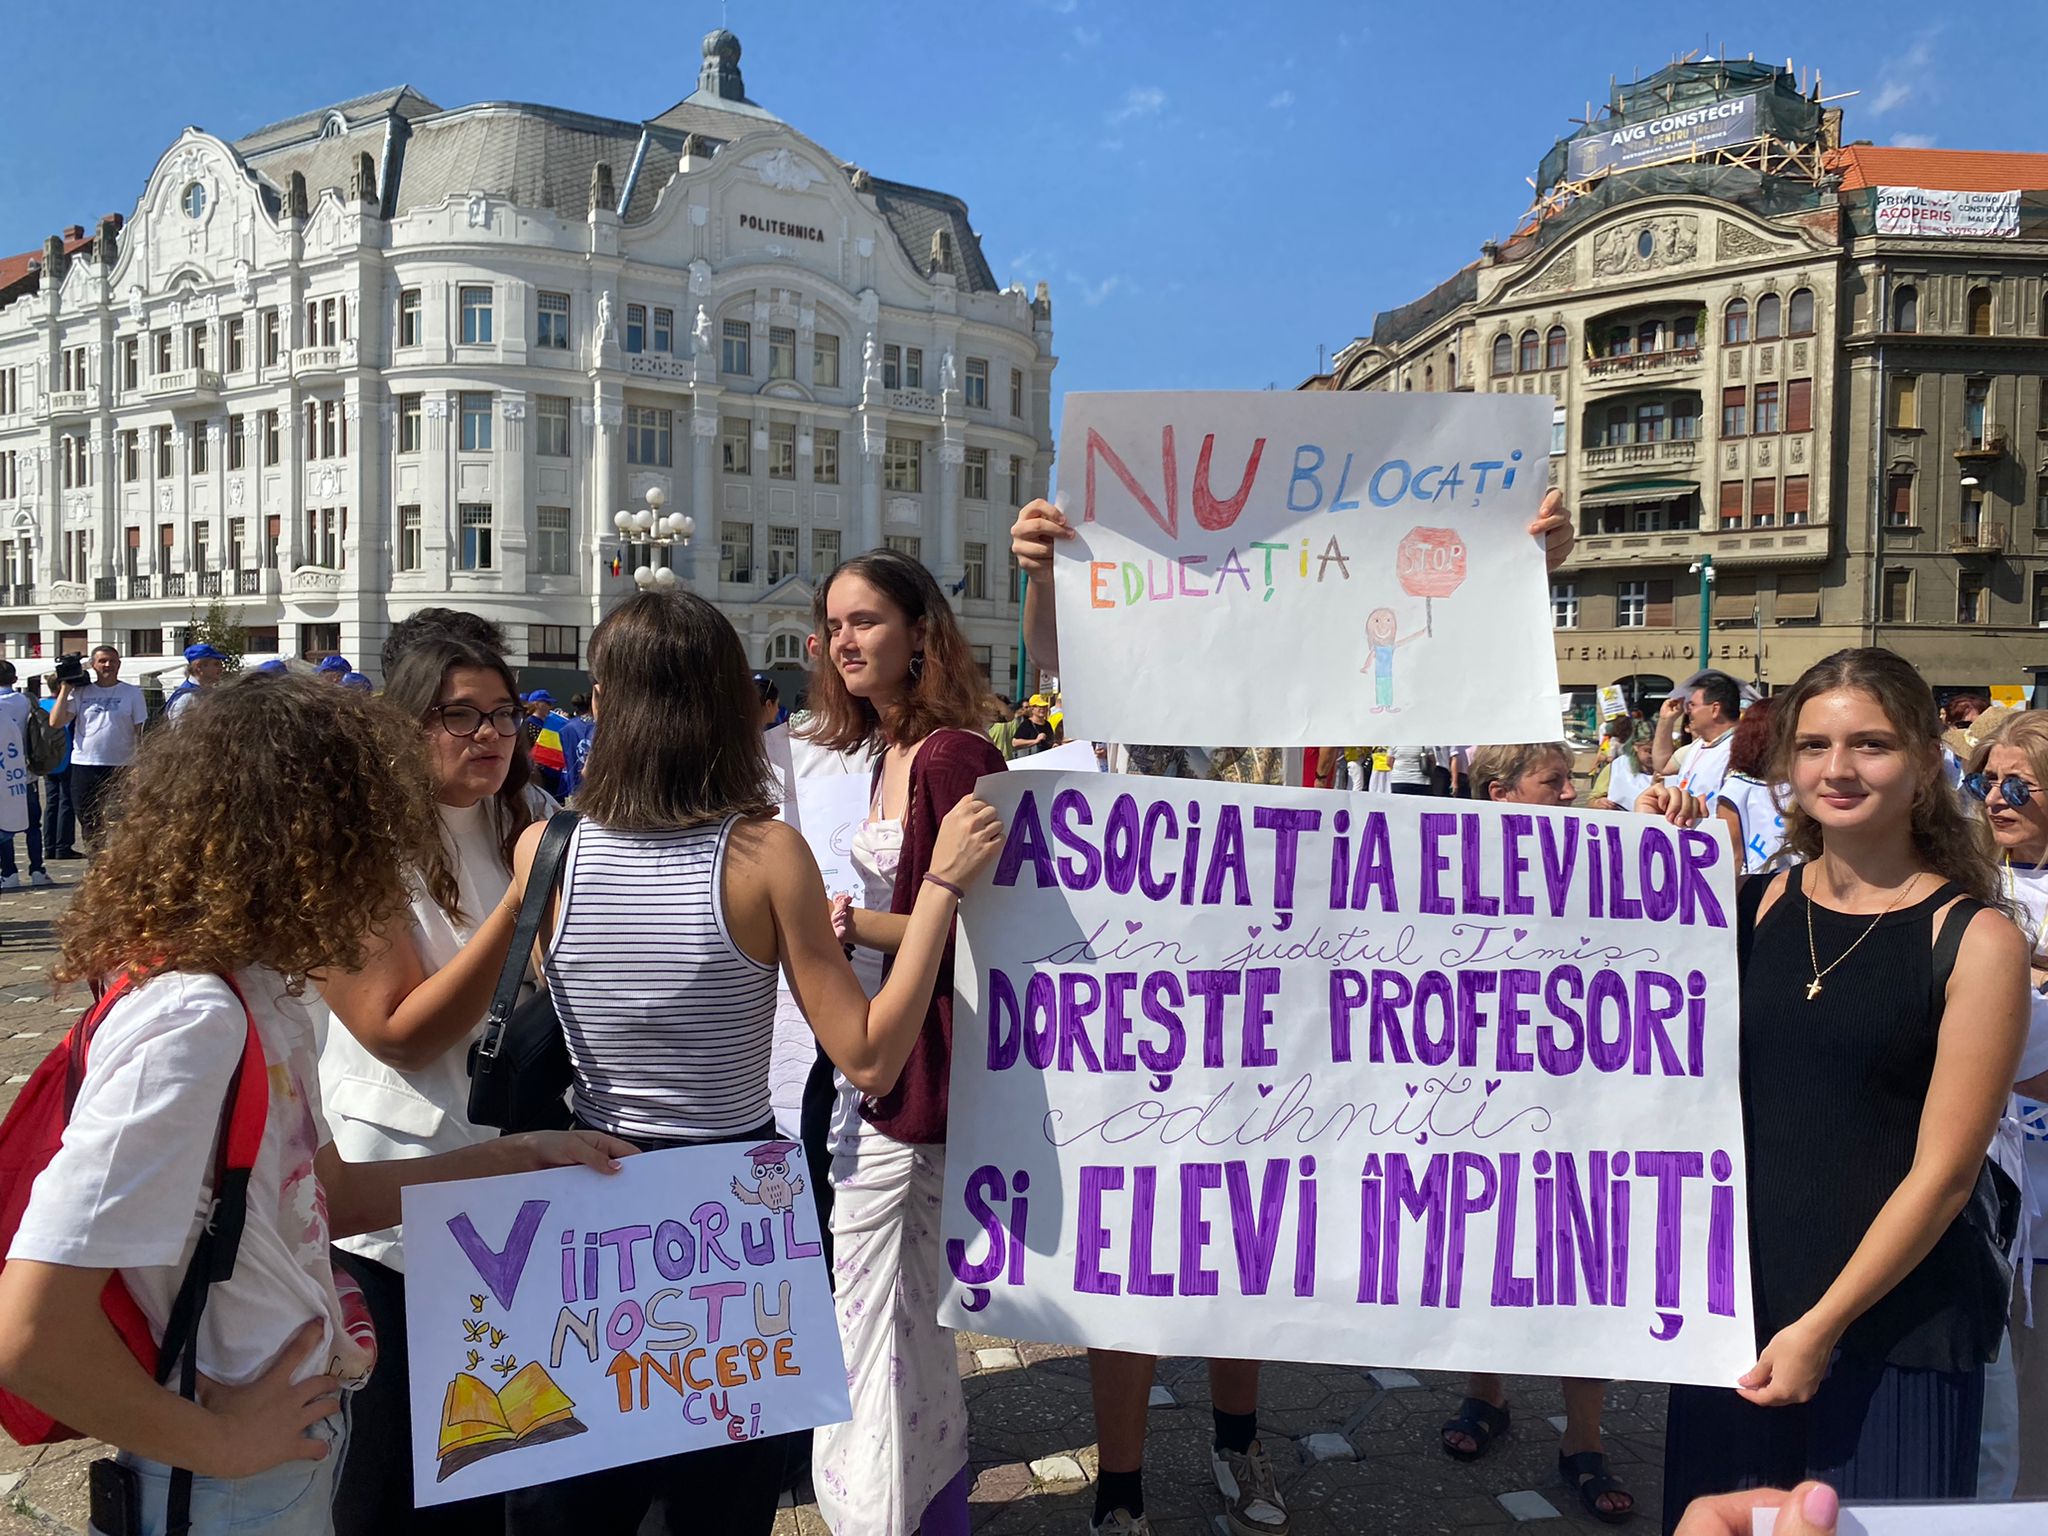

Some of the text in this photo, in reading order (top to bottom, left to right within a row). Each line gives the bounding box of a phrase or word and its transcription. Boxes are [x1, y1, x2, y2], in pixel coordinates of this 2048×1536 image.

[1611, 100, 1745, 147] AVG CONSTECH
[1877, 195, 1927, 207] PRIMUL
[740, 214, 824, 243] POLITEHNICA
[1084, 424, 1267, 540] NU
[1404, 542, 1461, 576] STOP
[1022, 918, 1199, 966] din
[549, 1280, 797, 1369] NOSTU
